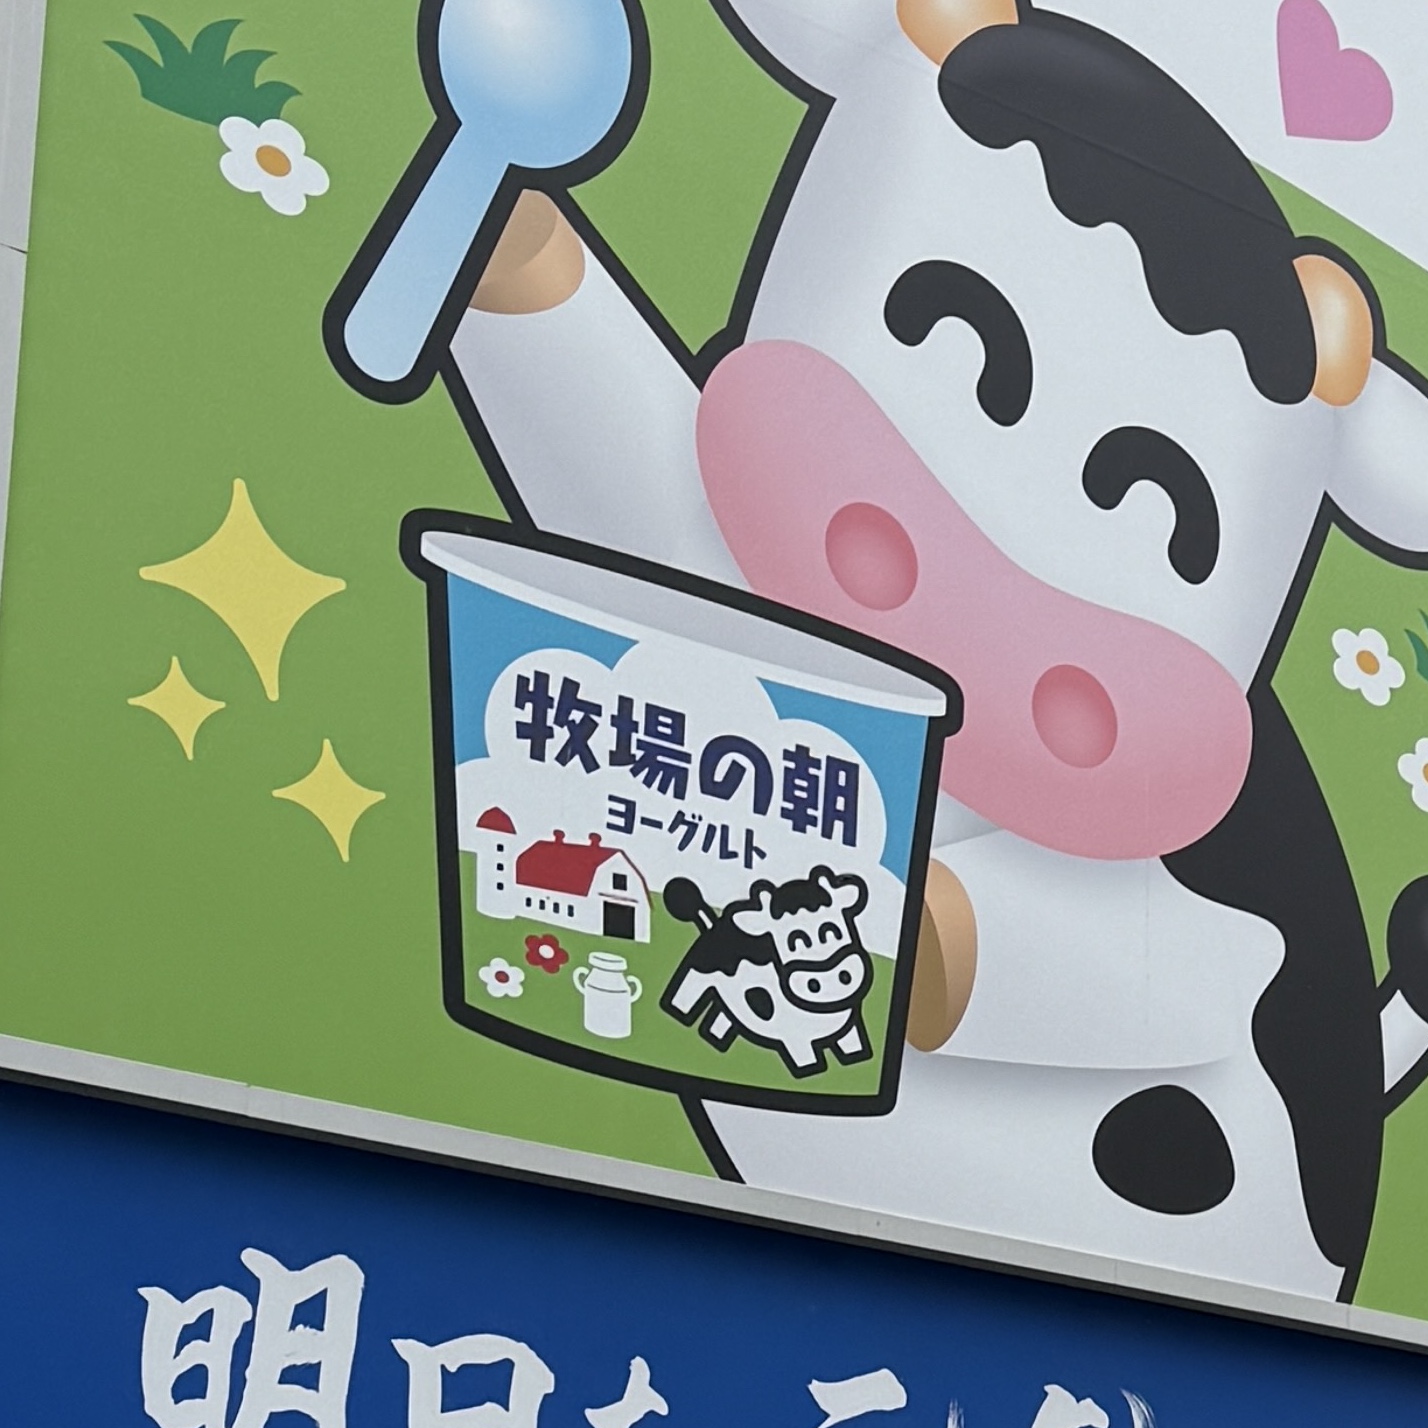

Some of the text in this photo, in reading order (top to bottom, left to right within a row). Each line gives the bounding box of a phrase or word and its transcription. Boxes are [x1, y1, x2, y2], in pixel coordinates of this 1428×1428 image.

[514, 671, 859, 848] 牧場の朝
[606, 795, 768, 869] ヨーグルト
